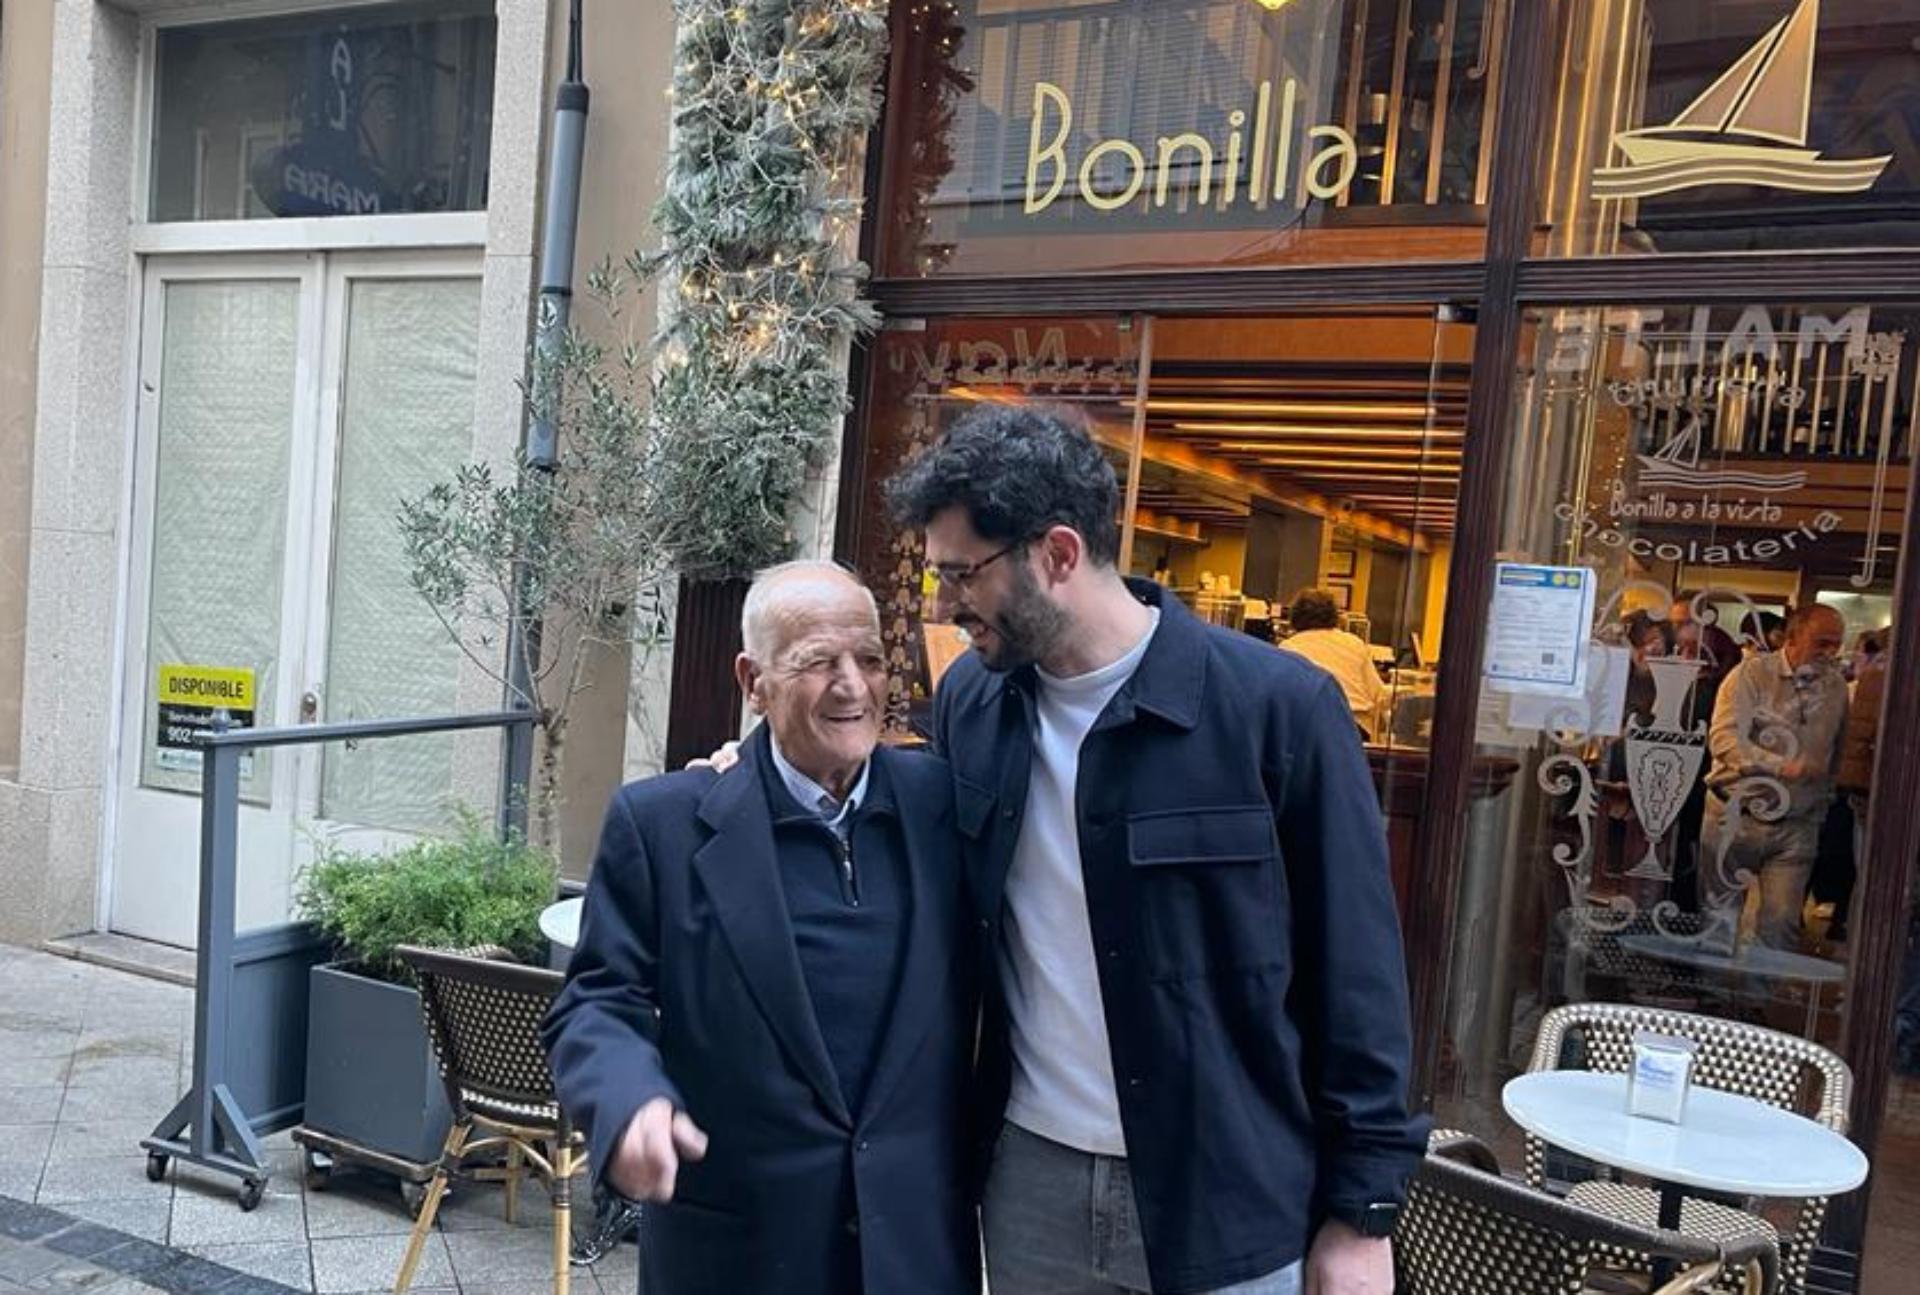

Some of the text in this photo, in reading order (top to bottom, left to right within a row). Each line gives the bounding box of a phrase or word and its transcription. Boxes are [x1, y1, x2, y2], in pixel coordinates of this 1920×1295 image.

[1024, 79, 1357, 214] Bonilla
[1610, 477, 1783, 522] Bonilla a la vista
[1554, 503, 1842, 563] chocolateria
[169, 677, 245, 699] DISPONIBLE
